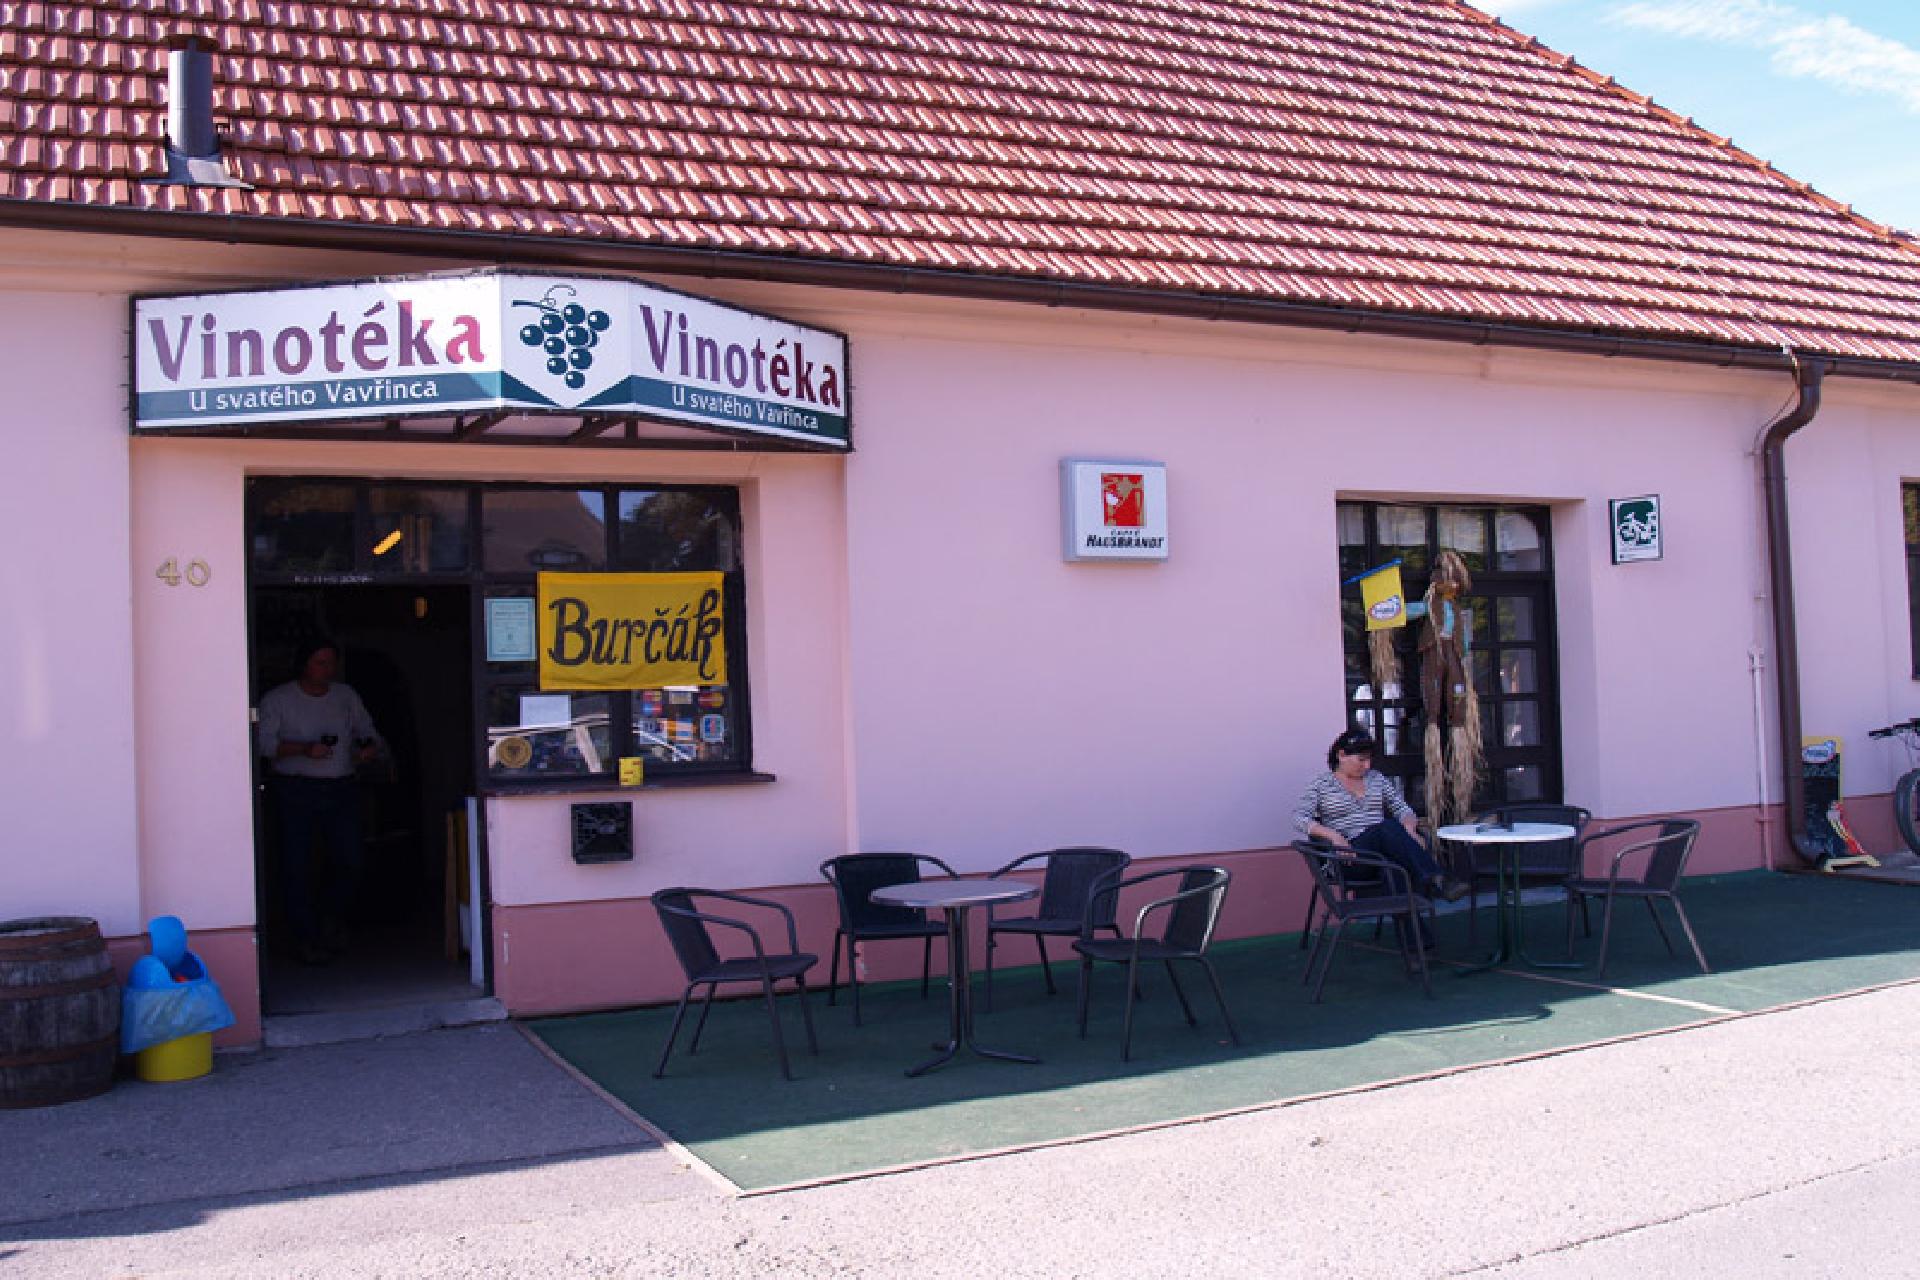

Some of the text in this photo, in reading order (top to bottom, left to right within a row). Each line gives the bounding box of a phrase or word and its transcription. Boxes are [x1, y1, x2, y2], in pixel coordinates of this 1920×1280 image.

[148, 299, 485, 383] Vinotéka
[640, 304, 841, 408] Vinotéka
[190, 378, 439, 412] U svatého Vavřinca
[672, 384, 685, 406] U
[690, 393, 752, 419] svatého
[155, 555, 212, 587] 40
[547, 588, 721, 681] Burčák
